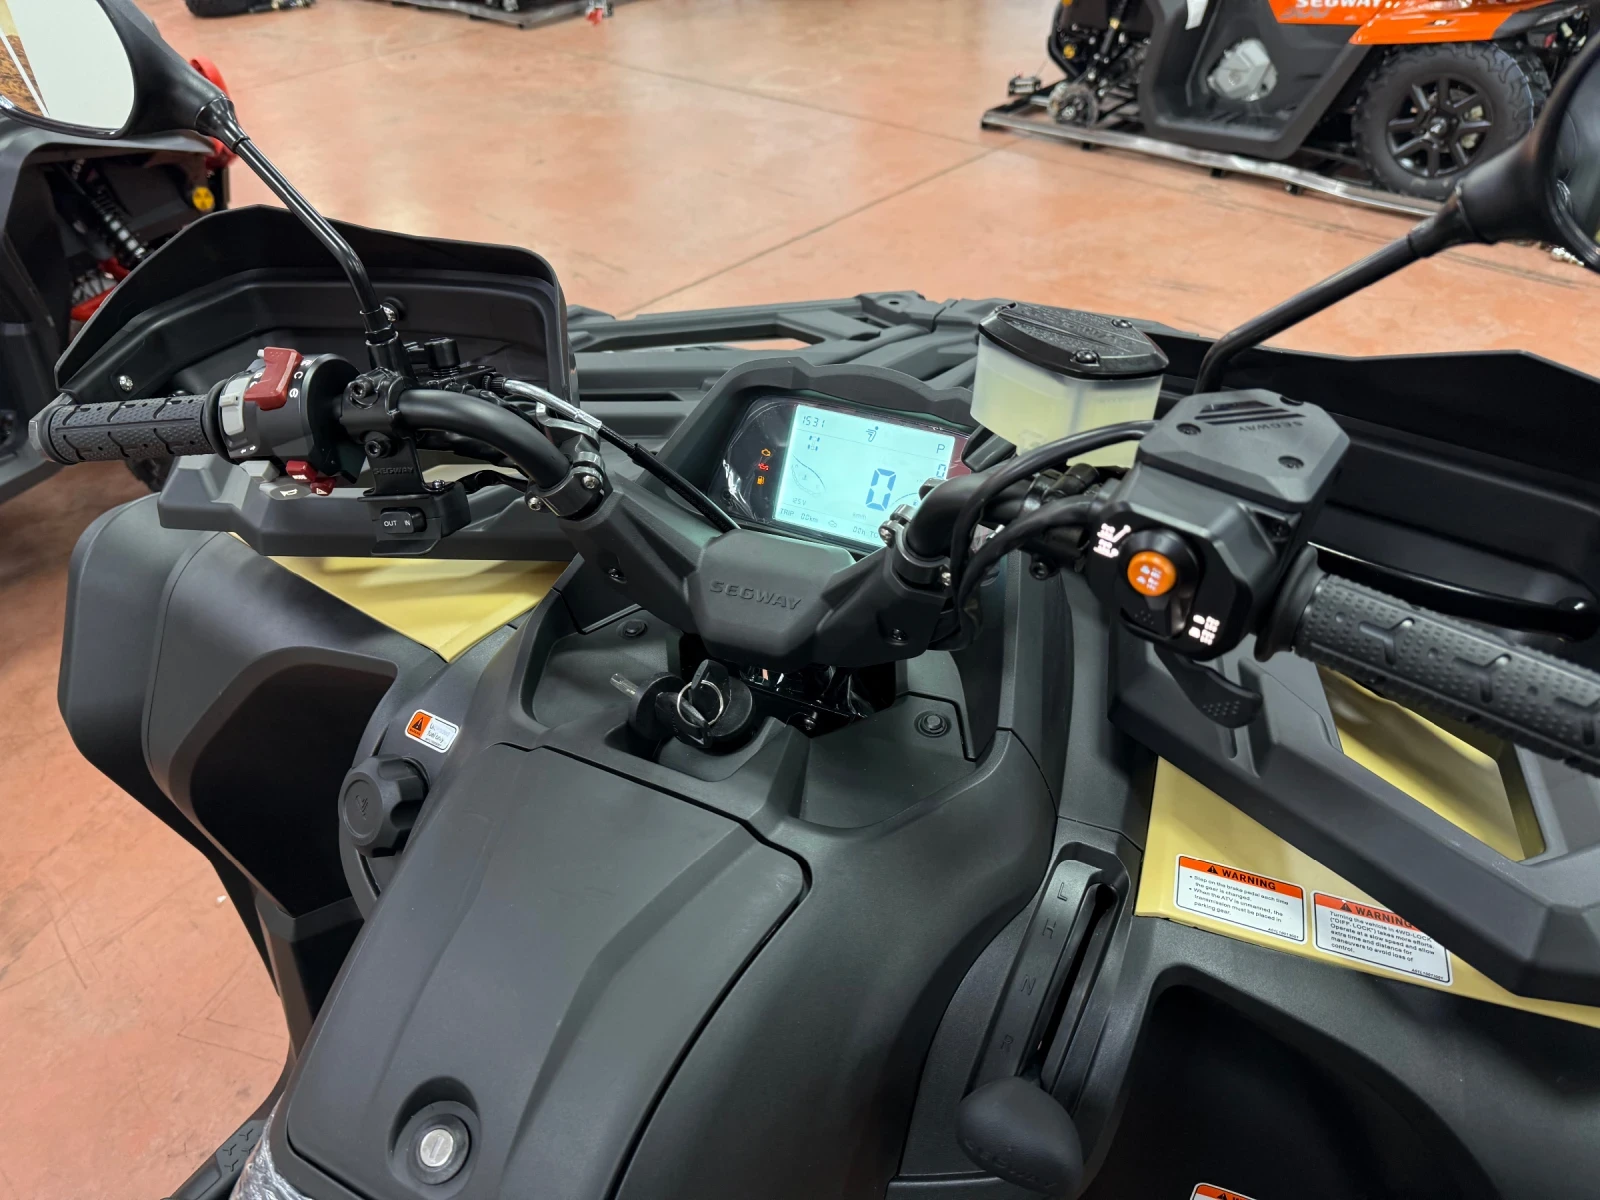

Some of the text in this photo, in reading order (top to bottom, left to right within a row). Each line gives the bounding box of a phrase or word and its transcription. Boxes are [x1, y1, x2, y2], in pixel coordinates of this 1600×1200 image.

[936, 444, 945, 453] P
[373, 466, 414, 475] SEGWAY
[866, 468, 896, 511] 0
[780, 508, 794, 516] TRIP
[710, 581, 801, 610] SEGWAY
[1222, 868, 1276, 890] WARNING
[1057, 882, 1068, 901] L
[1194, 902, 1215, 911] parking
[1195, 894, 1230, 908] transmission
[1256, 912, 1275, 920] placed
[1330, 911, 1352, 921] Turning
[1365, 921, 1387, 930] vehicle
[1330, 923, 1355, 934] Operate
[1385, 938, 1404, 946] speed
[1331, 930, 1346, 938] extra
[1376, 942, 1402, 952] distance
[1378, 930, 1394, 938] takes
[1331, 936, 1365, 949] maneuvers
[1374, 948, 1391, 956] avoid
[1393, 952, 1406, 960] loss
